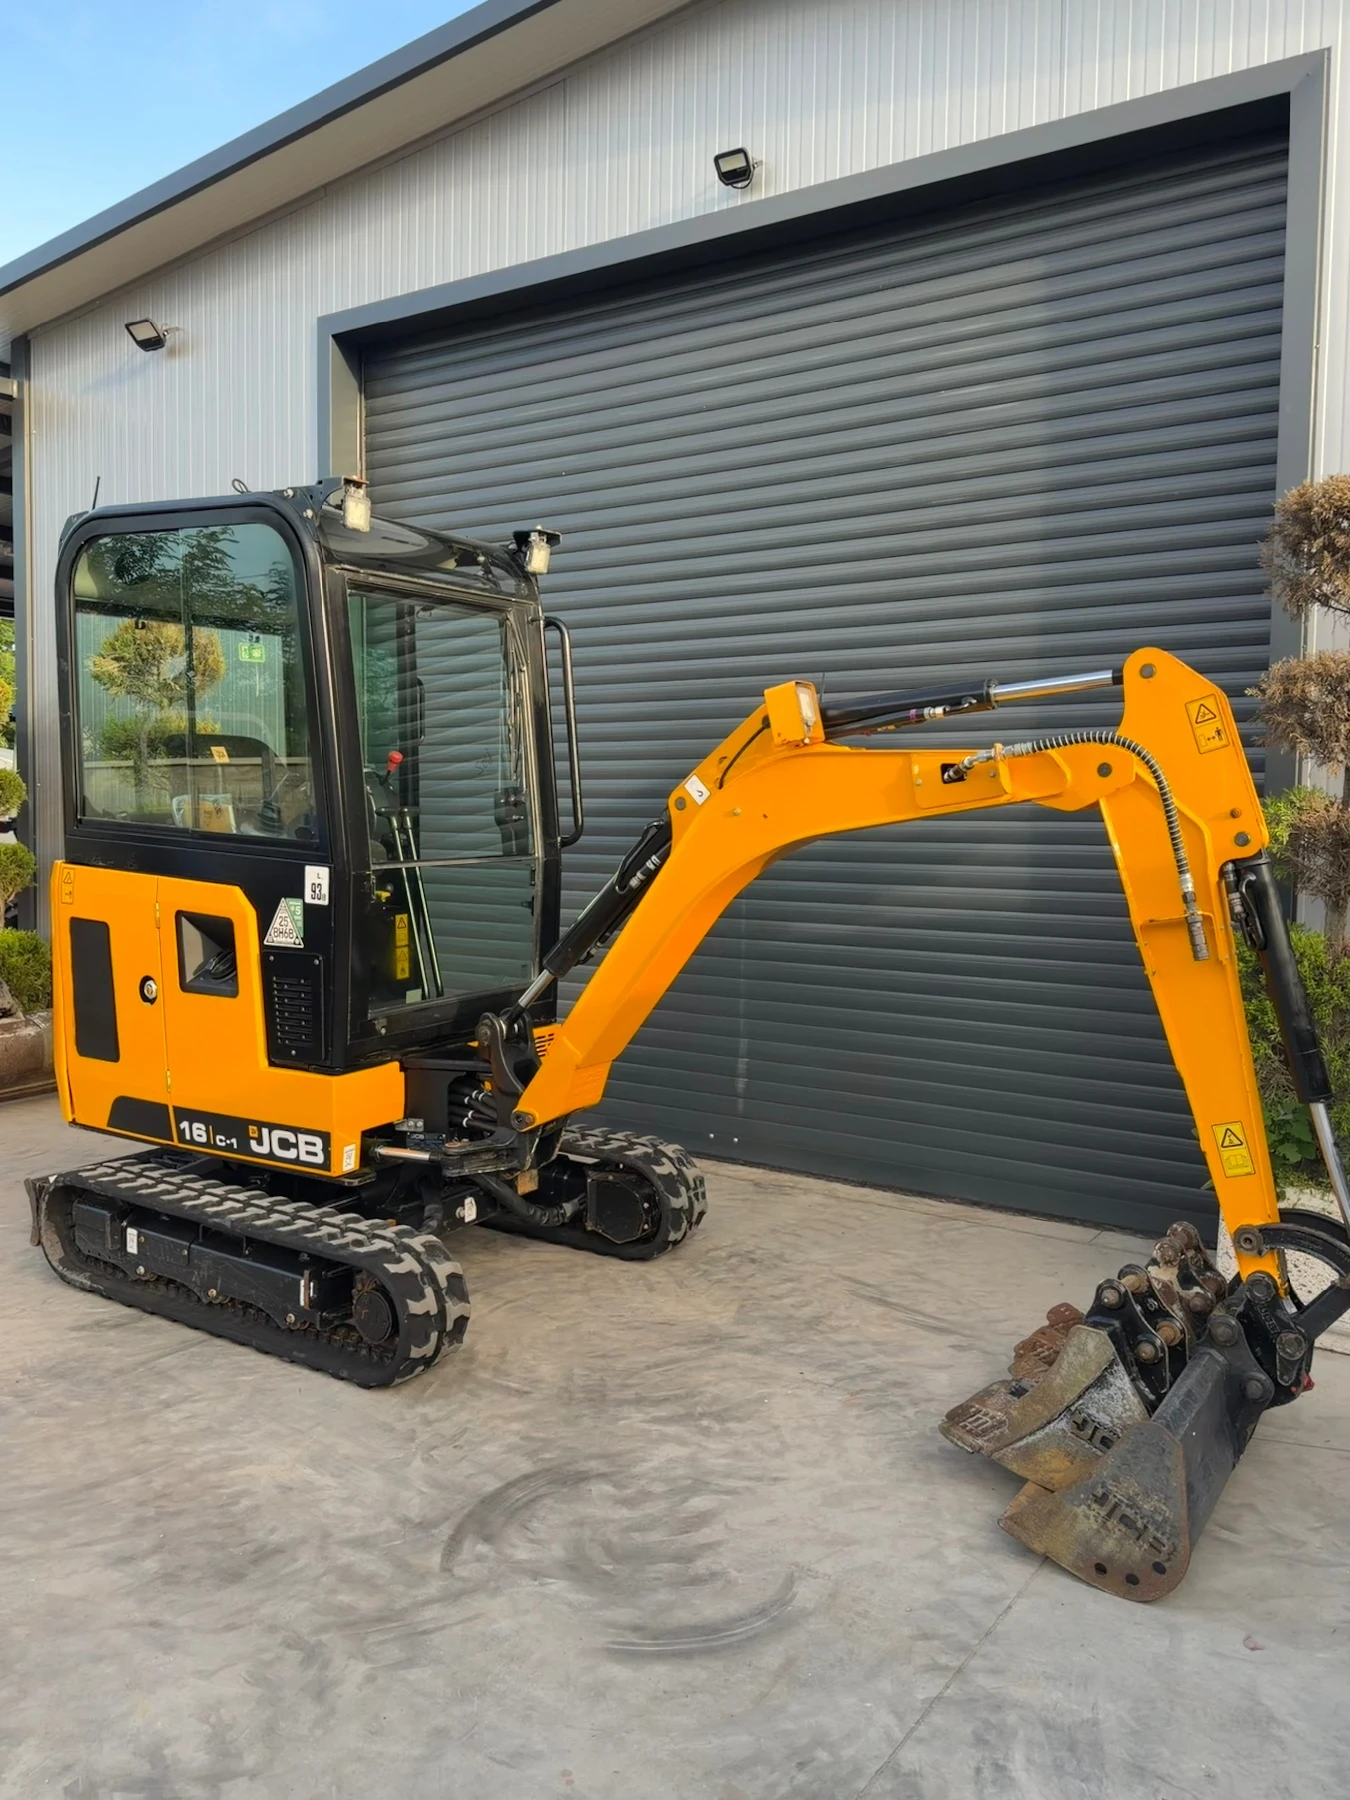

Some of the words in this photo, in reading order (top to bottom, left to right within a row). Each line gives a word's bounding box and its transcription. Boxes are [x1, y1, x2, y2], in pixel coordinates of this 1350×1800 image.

[311, 882, 322, 900] 93
[278, 916, 289, 927] 25
[179, 1120, 208, 1143] 16
[249, 1126, 325, 1165] JCB
